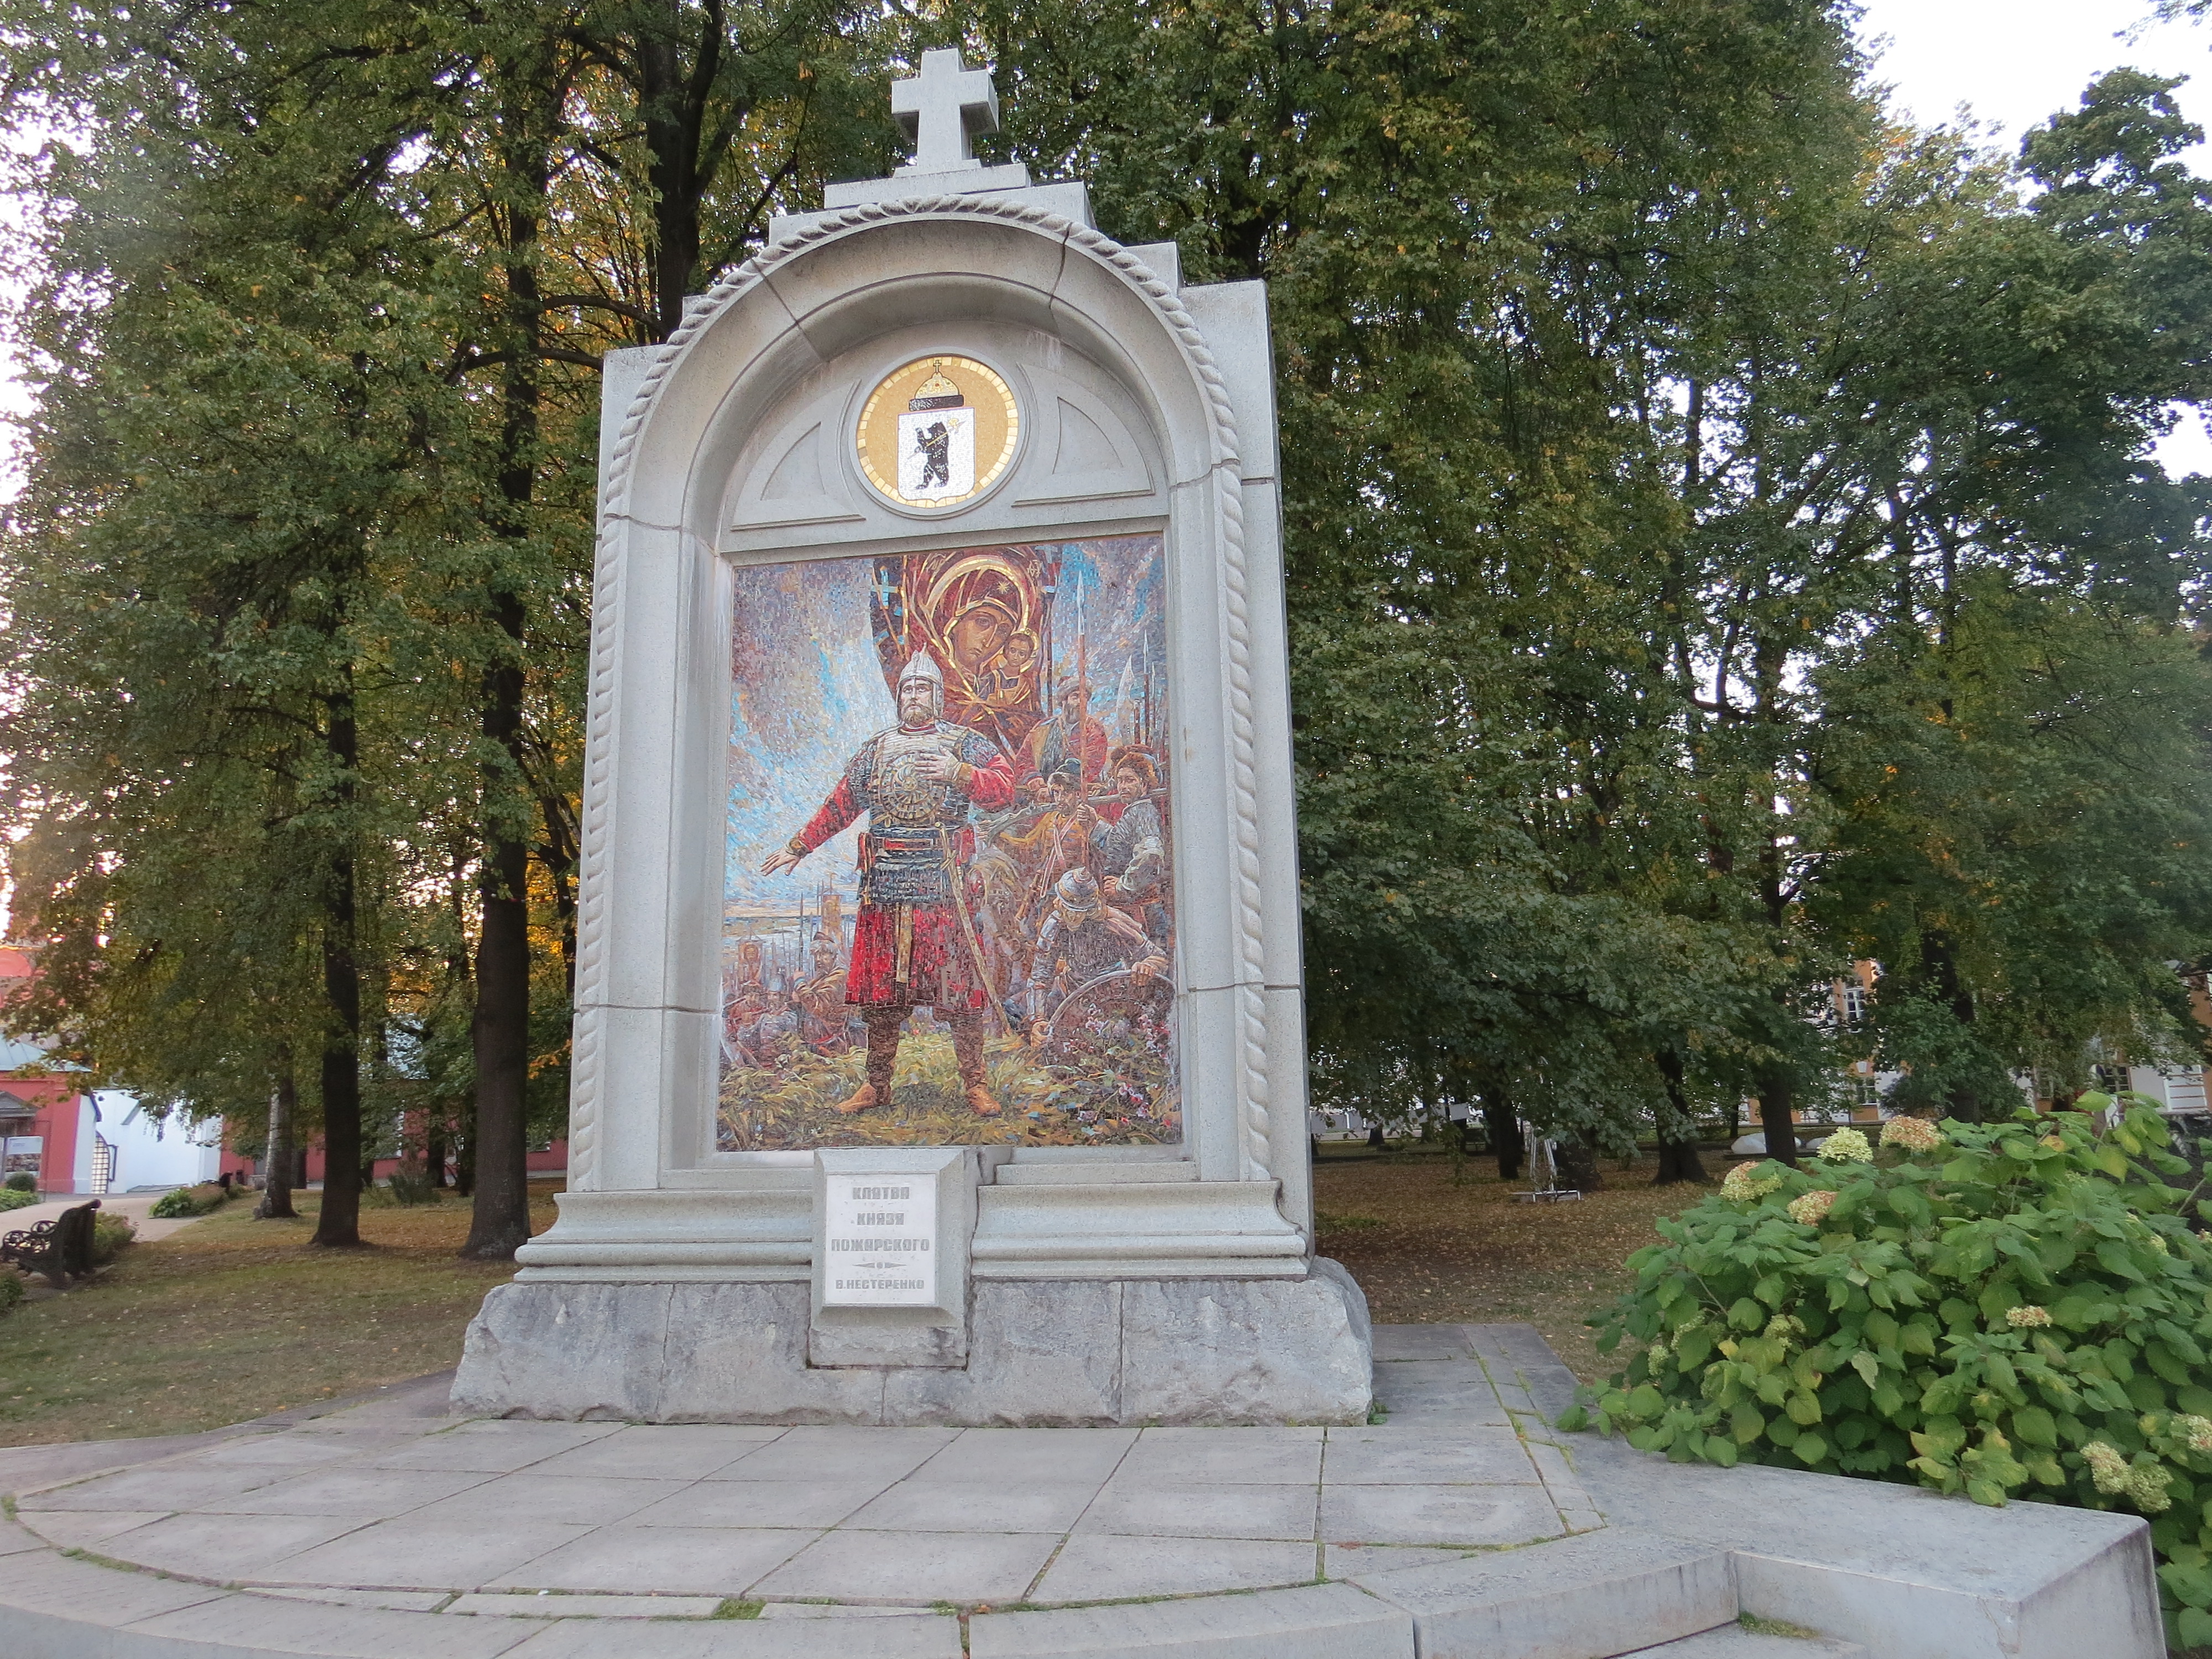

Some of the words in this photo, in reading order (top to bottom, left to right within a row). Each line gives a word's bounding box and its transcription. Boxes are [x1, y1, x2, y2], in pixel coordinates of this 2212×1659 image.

[852, 1187, 910, 1199] КЛЯТВА
[857, 1213, 904, 1225] КНЯЗЯ
[831, 1239, 930, 1251] ПОЖАРСКОГО
